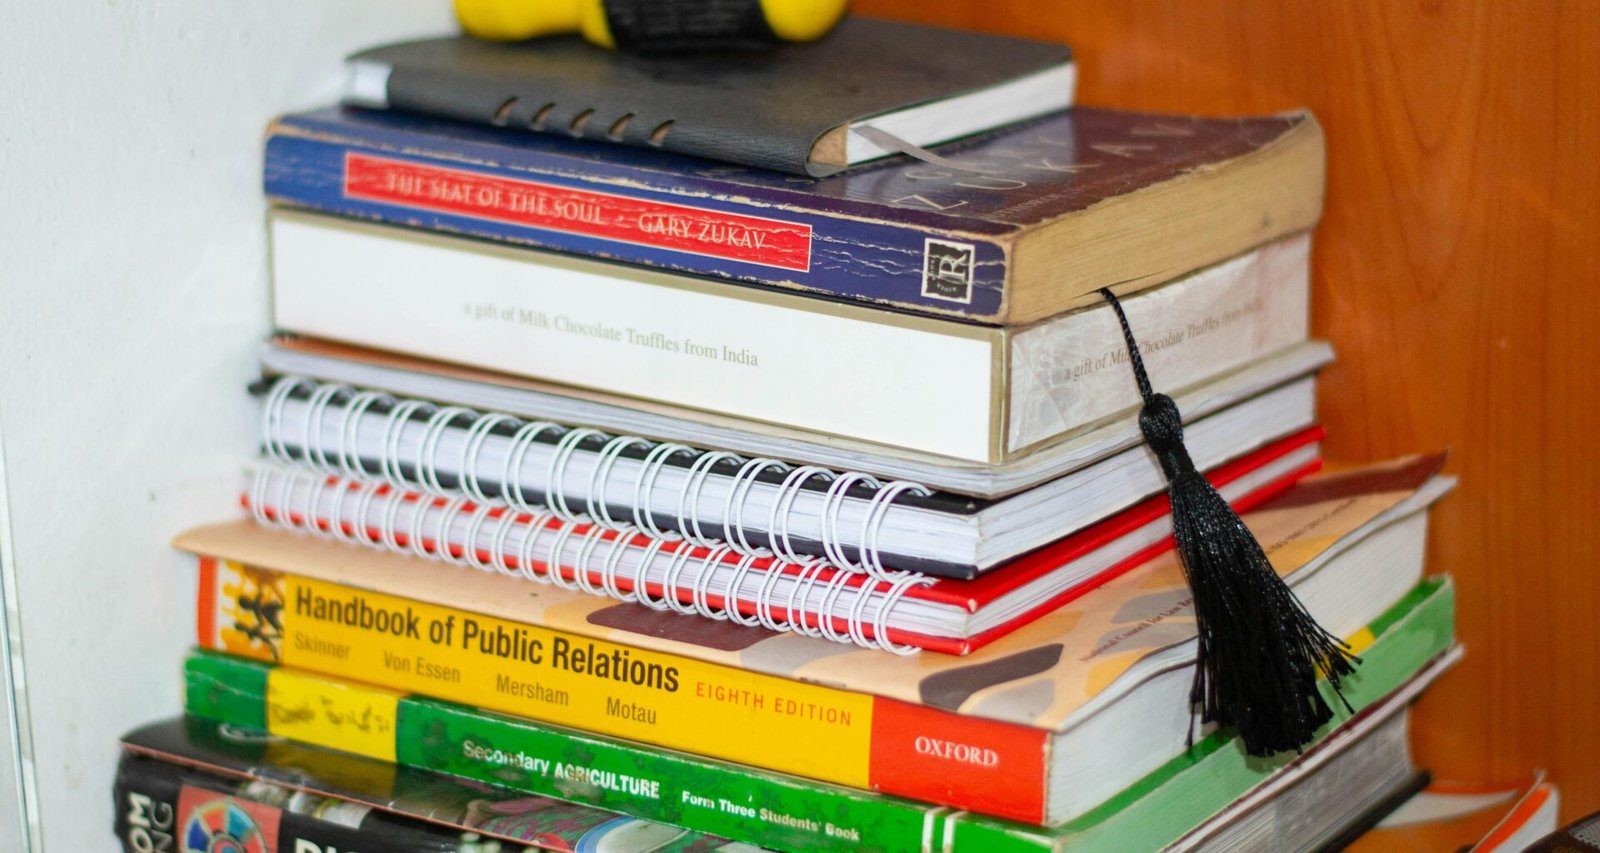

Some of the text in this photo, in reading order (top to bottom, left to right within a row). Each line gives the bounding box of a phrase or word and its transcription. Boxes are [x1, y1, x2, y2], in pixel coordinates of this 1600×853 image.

[889, 122, 1195, 210] ZUKAV
[387, 172, 767, 250] THE SEAT OF THE SOUL GARY ZUKAV
[463, 302, 759, 367] a gift of Milk Chocolate Truffles from India
[1064, 368, 1072, 380] a
[1073, 358, 1093, 382] gift
[1094, 352, 1109, 370] of
[1110, 346, 1132, 368] Mil
[1186, 316, 1220, 340] Truffles
[295, 631, 657, 725] Skinner Von Essen Mersham Motau
[296, 586, 680, 693] Handbook of Public Relations
[695, 681, 852, 727] EIGHTH EDITION
[463, 739, 860, 841] Secondary AGRICULTURE Form Three Students' Book
[913, 735, 999, 768] OXFORD
